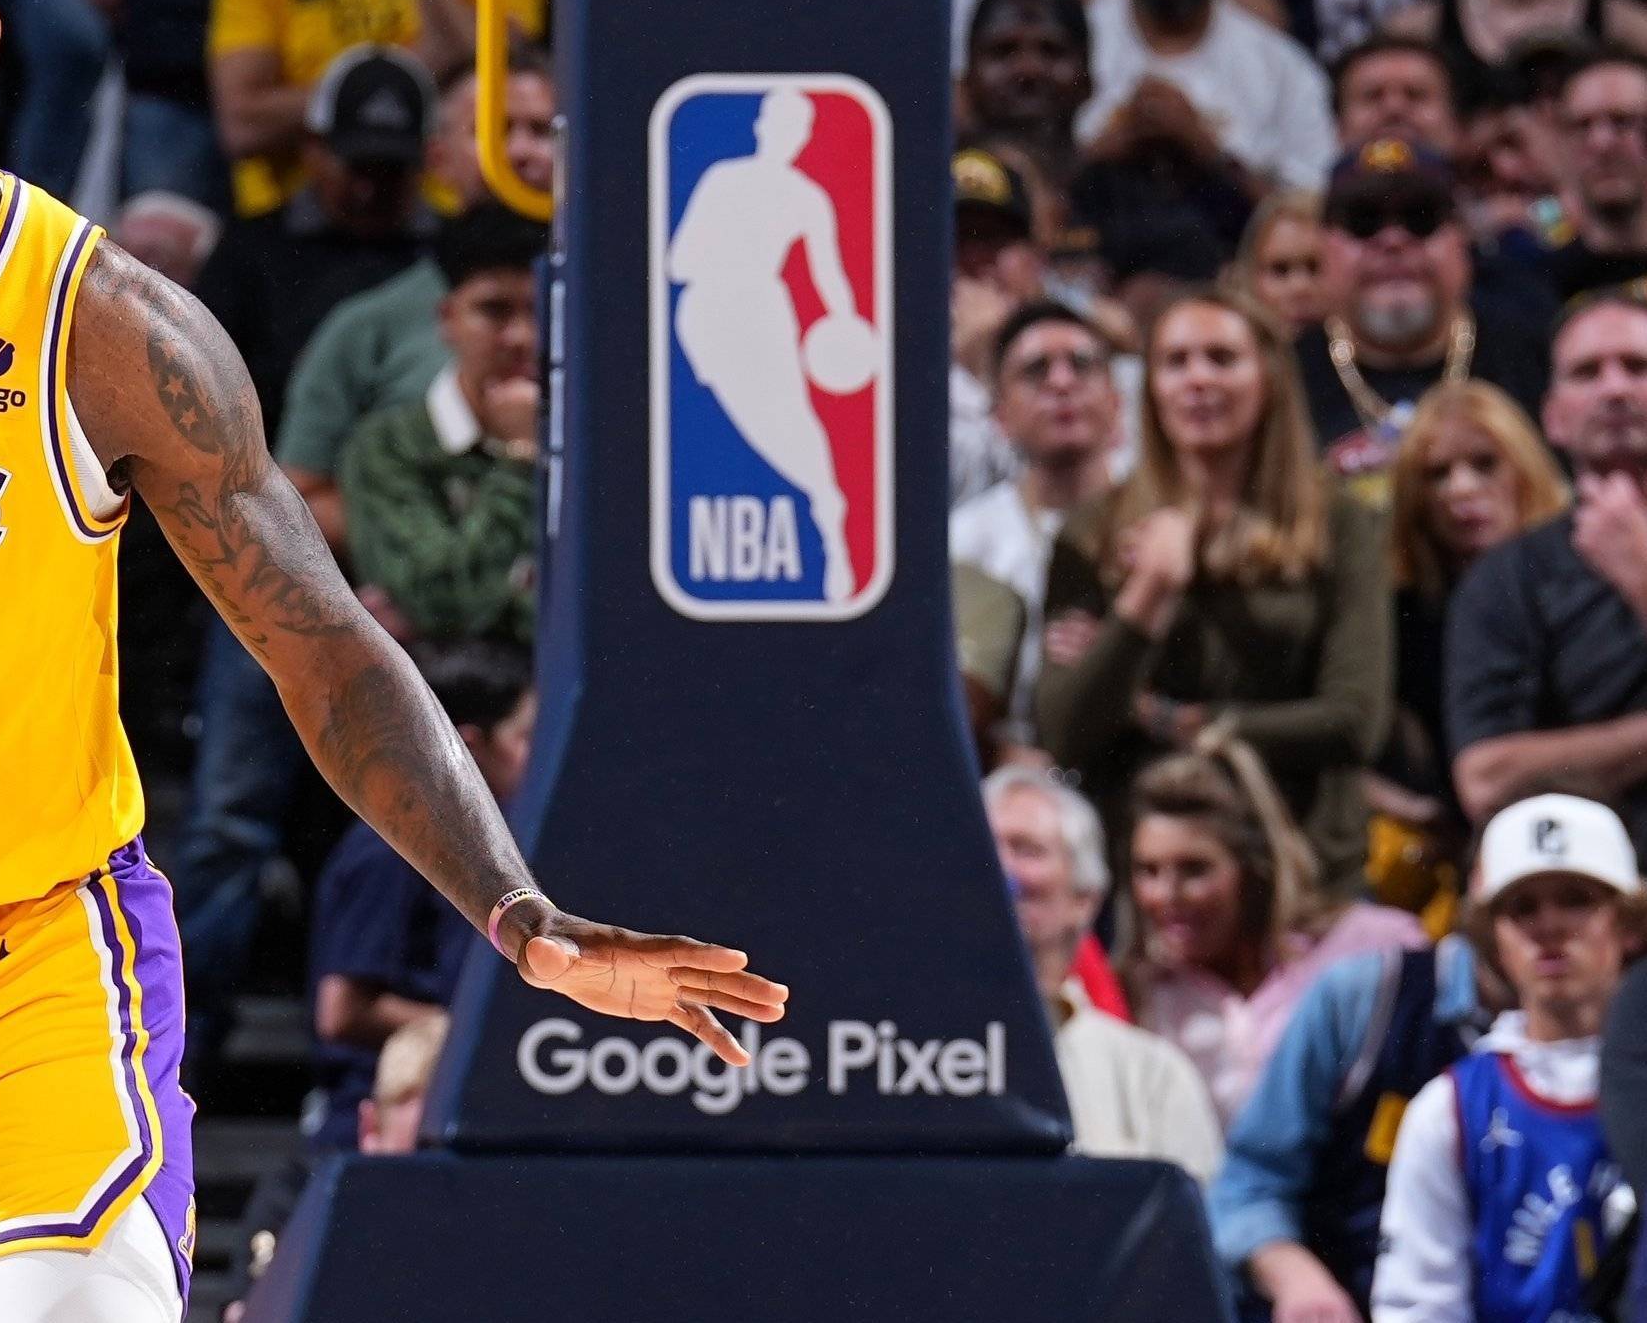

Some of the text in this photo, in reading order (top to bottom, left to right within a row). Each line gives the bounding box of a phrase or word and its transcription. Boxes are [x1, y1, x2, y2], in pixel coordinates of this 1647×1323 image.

[688, 493, 803, 583] NBA
[517, 1018, 1007, 1114] Google Pixel
